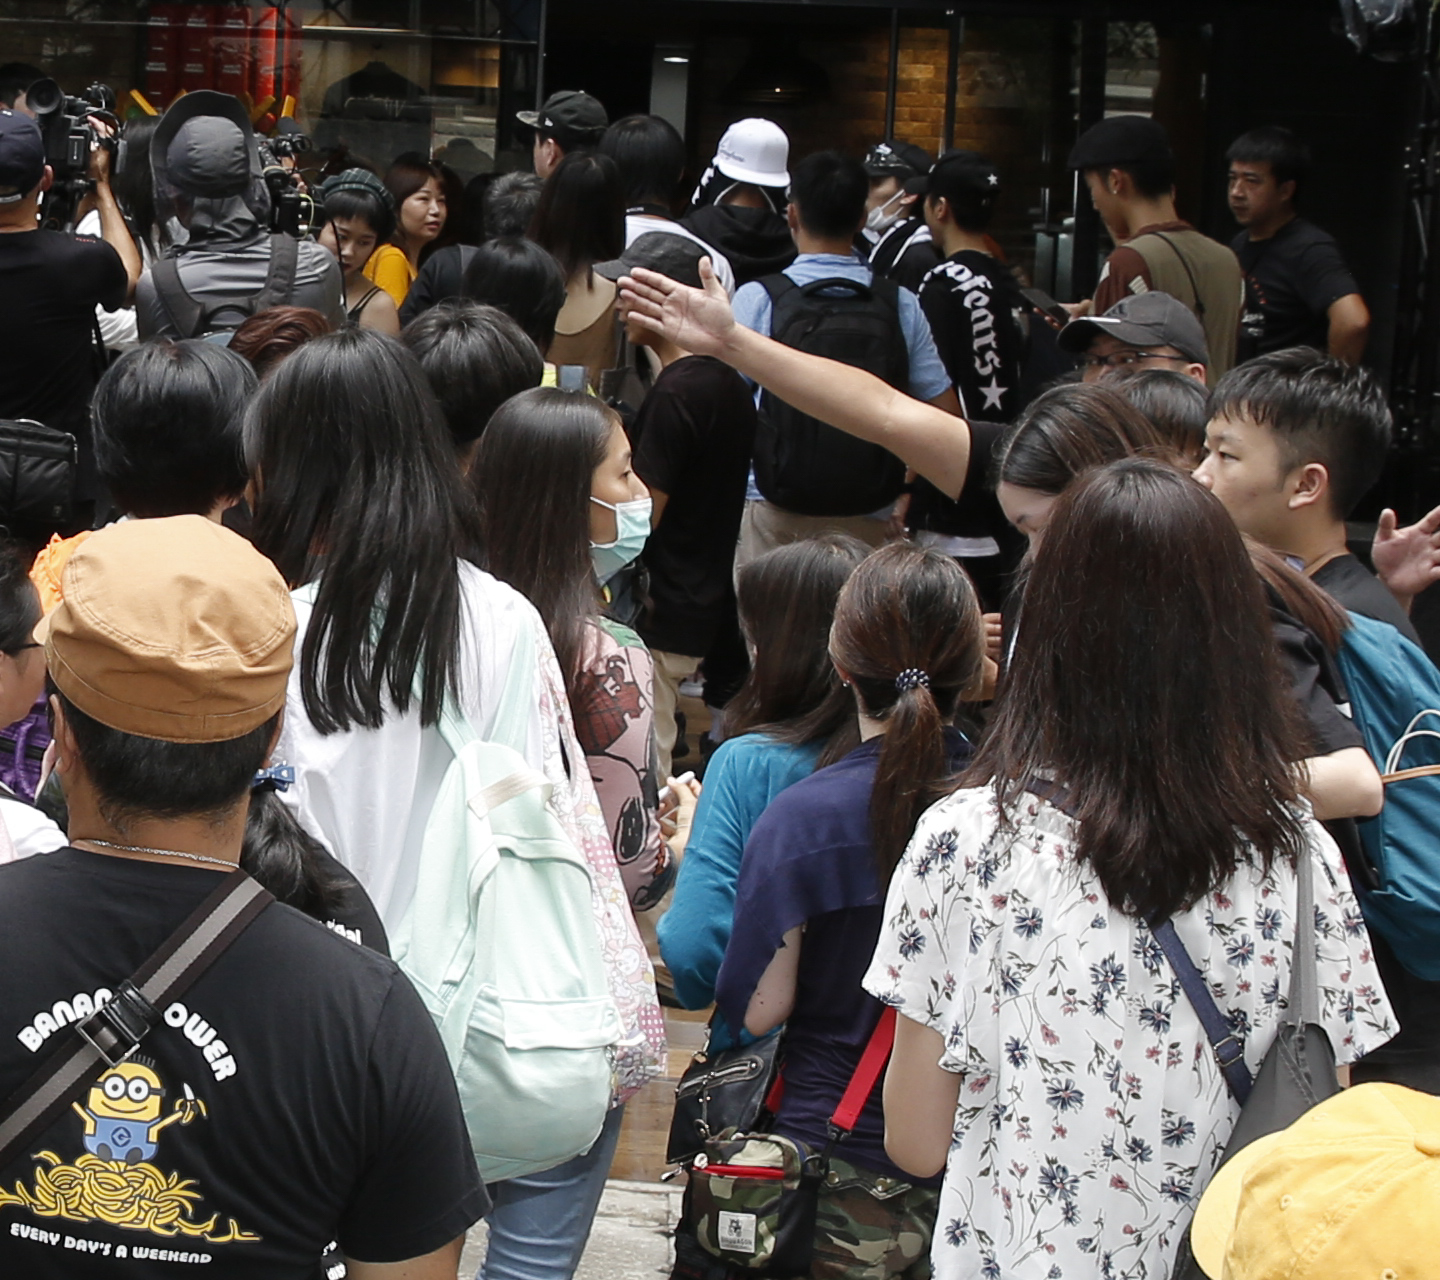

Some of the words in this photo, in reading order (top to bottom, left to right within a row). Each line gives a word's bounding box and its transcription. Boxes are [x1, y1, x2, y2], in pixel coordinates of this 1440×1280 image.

[17, 987, 114, 1053] BANAN
[163, 1002, 238, 1082] OWER
[10, 1222, 62, 1246] EVERY
[64, 1235, 112, 1257] DAY'S
[115, 1245, 128, 1258] A
[132, 1246, 213, 1264] WEEKEND
